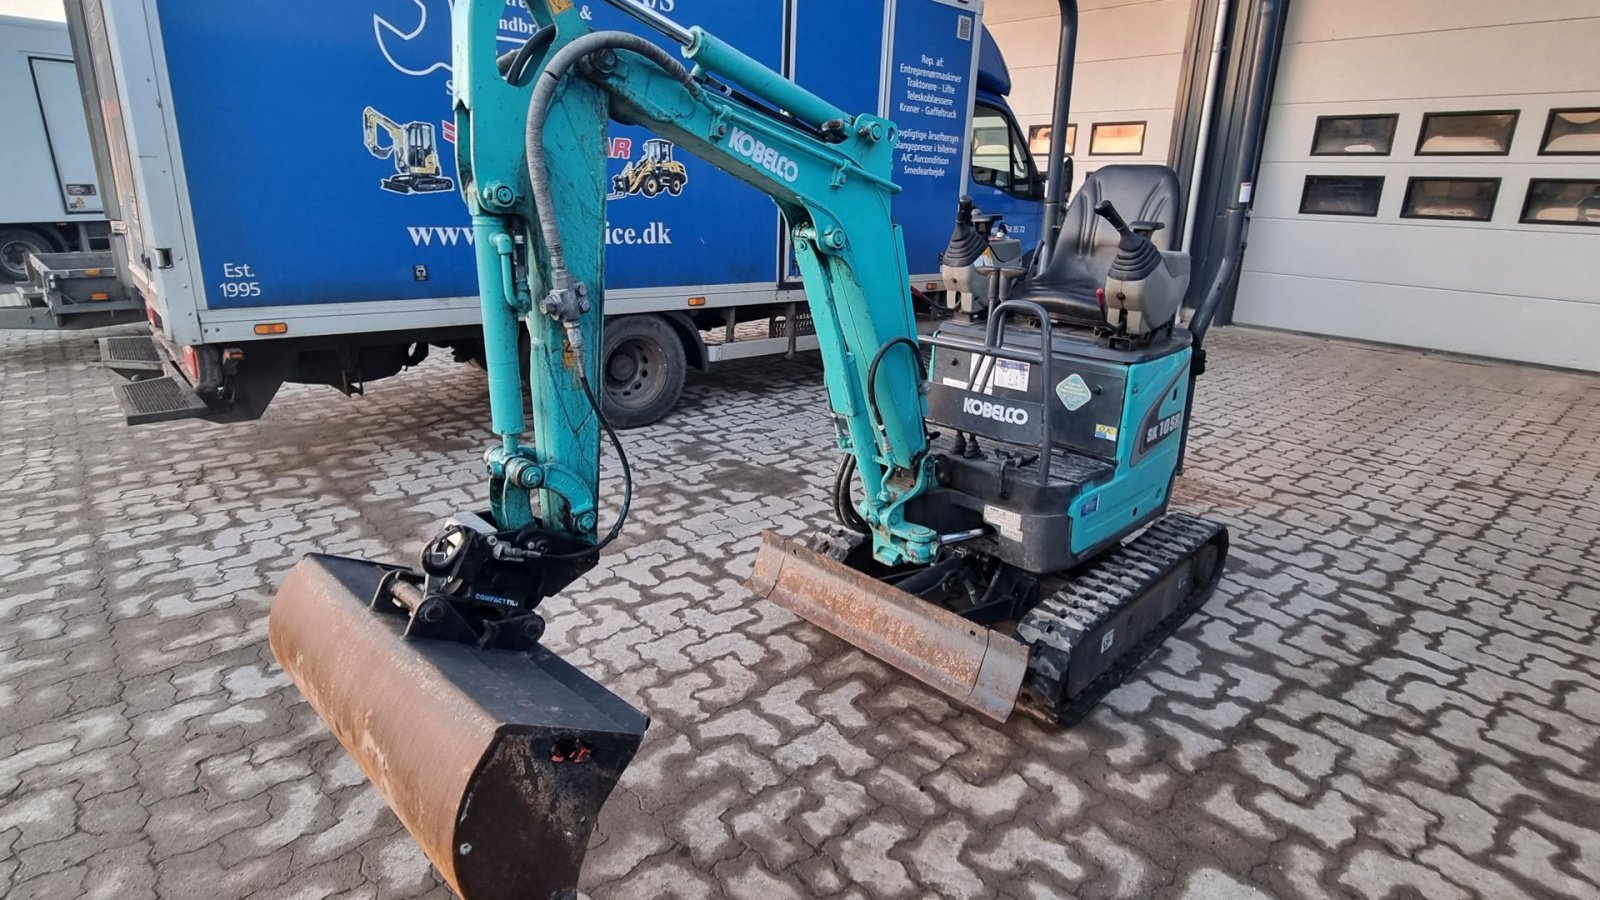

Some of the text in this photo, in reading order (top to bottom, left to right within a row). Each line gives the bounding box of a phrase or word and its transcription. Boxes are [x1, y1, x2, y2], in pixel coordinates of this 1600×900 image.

[579, 5, 593, 21] &
[921, 54, 935, 67] Rep.
[942, 84, 956, 95] Lifte
[899, 102, 920, 114] Kraner
[925, 106, 957, 119] Gaffeltruck
[728, 126, 799, 183] KOBELCO
[901, 153, 949, 165] A/C Aircondition
[605, 221, 672, 245] ice.dk
[223, 263, 255, 278] Est.
[219, 282, 261, 298] 1995
[962, 397, 1029, 426] KOBELCO
[1146, 425, 1159, 443] SK
